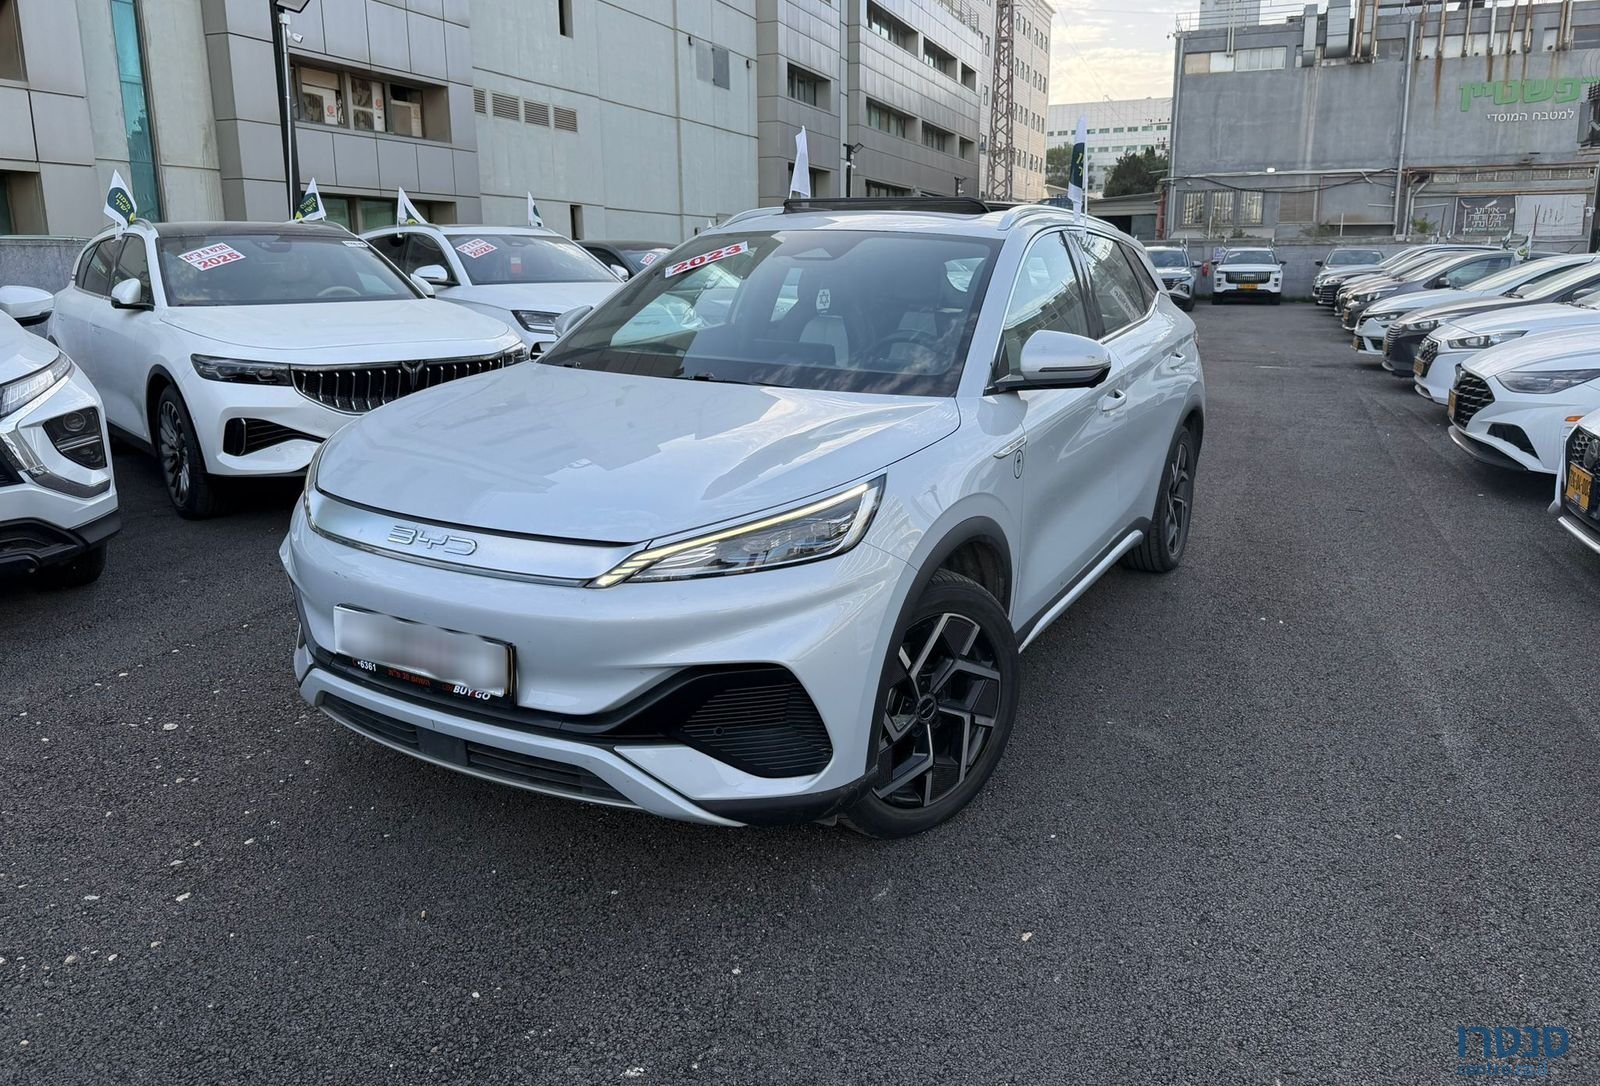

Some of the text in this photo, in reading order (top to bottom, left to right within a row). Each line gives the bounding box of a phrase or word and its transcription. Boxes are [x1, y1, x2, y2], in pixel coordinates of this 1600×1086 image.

[1460, 77, 1600, 112] פשטיין
[1487, 108, 1575, 122] למטבח המוסדי
[671, 245, 742, 274] 2023
[388, 525, 478, 556] BYD
